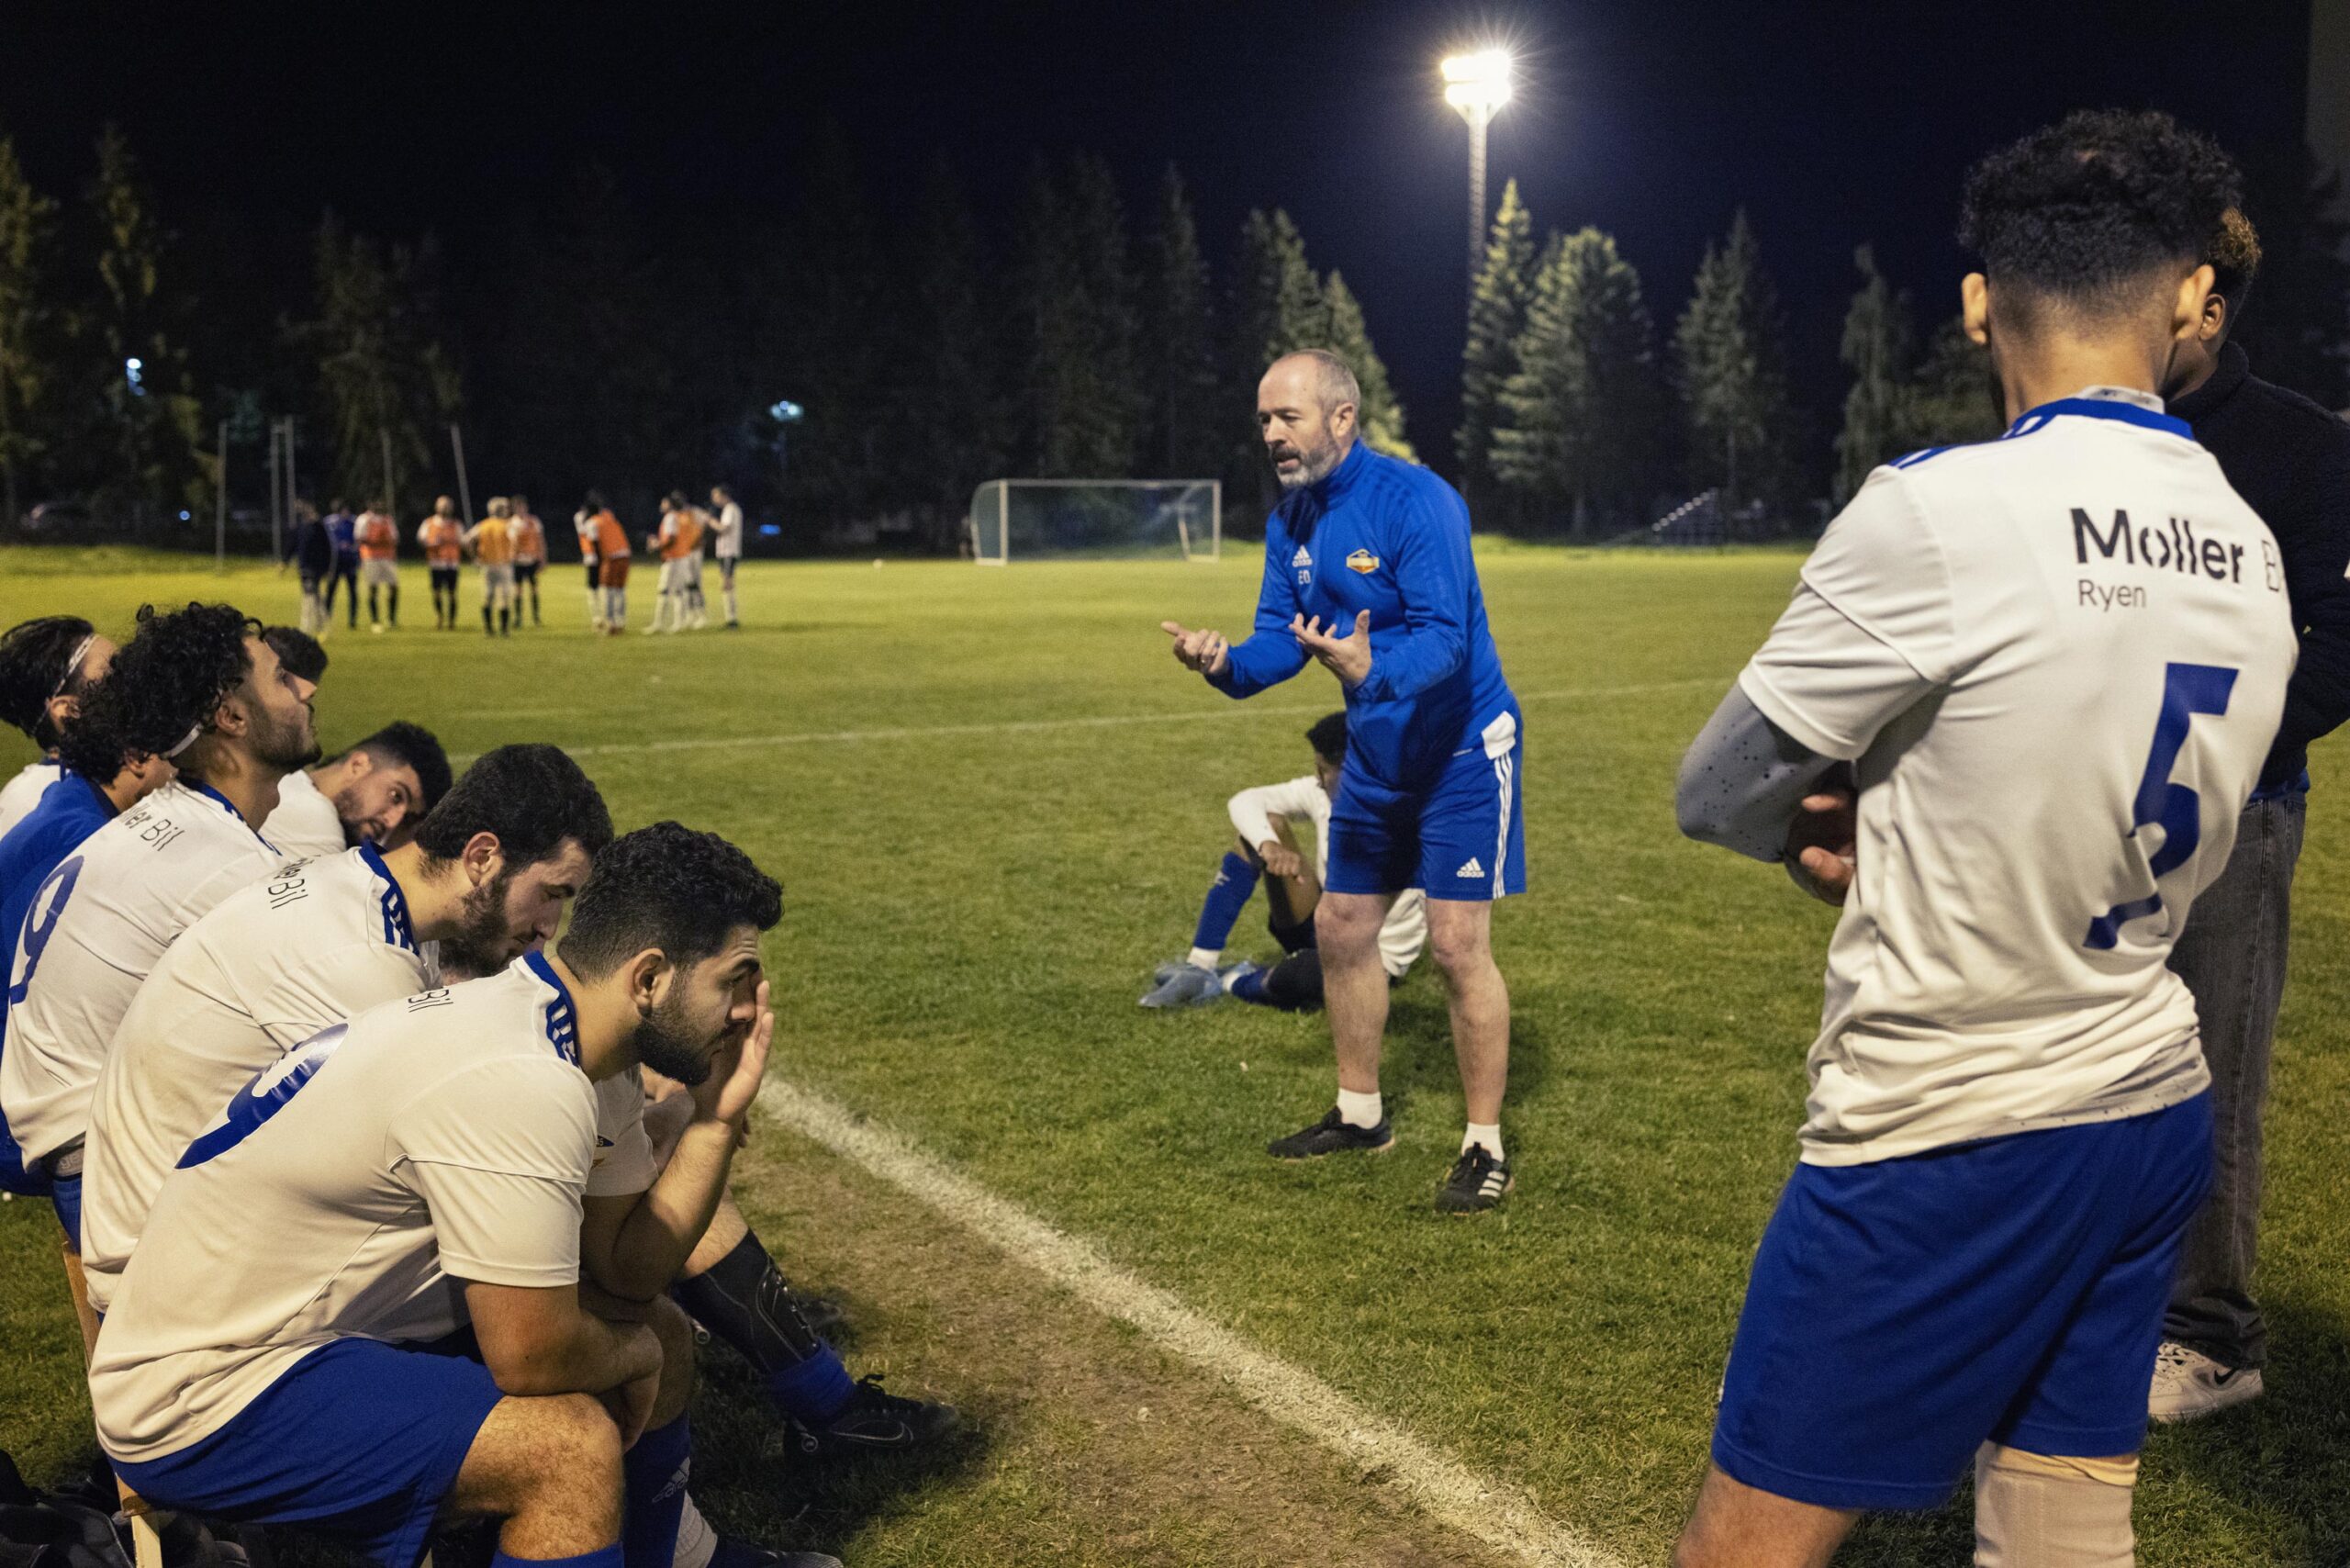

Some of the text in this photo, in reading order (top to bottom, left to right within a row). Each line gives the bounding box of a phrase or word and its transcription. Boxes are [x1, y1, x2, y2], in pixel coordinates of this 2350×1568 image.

[2078, 578, 2147, 612] Ryen
[140, 818, 185, 852] Bil
[2082, 662, 2240, 950] 5
[9, 855, 84, 1005] 9
